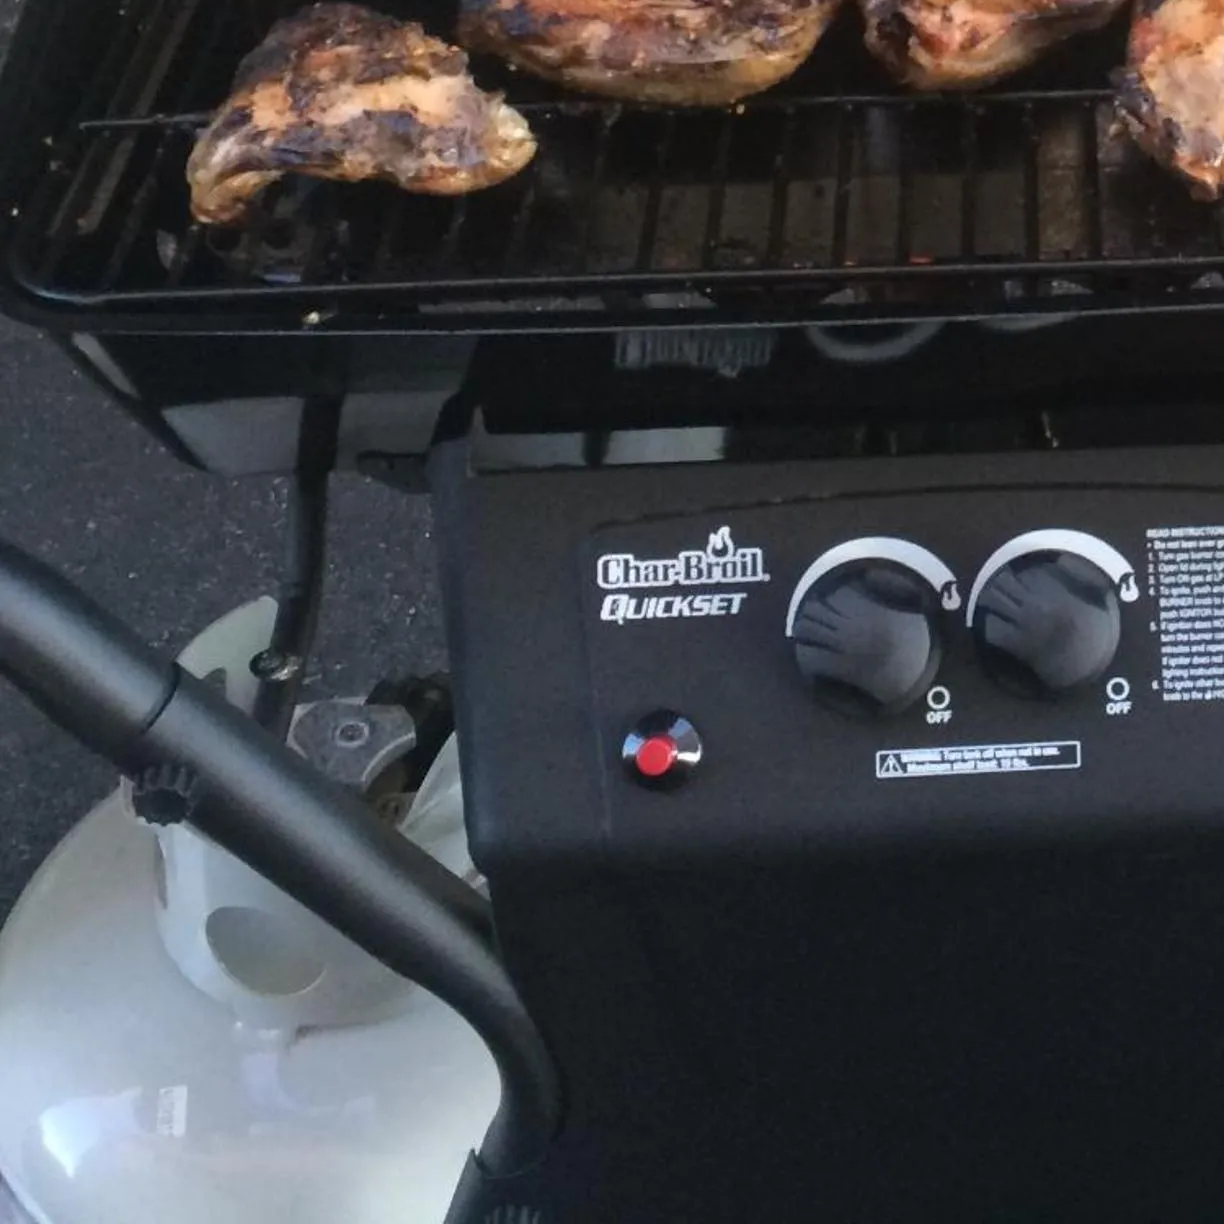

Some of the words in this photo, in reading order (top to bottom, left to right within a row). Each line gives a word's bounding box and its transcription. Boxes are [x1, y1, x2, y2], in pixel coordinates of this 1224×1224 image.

[597, 545, 764, 589] Char-Broil
[600, 592, 748, 625] QUICKSET
[926, 710, 952, 724] OFF
[1106, 701, 1132, 715] OFF
